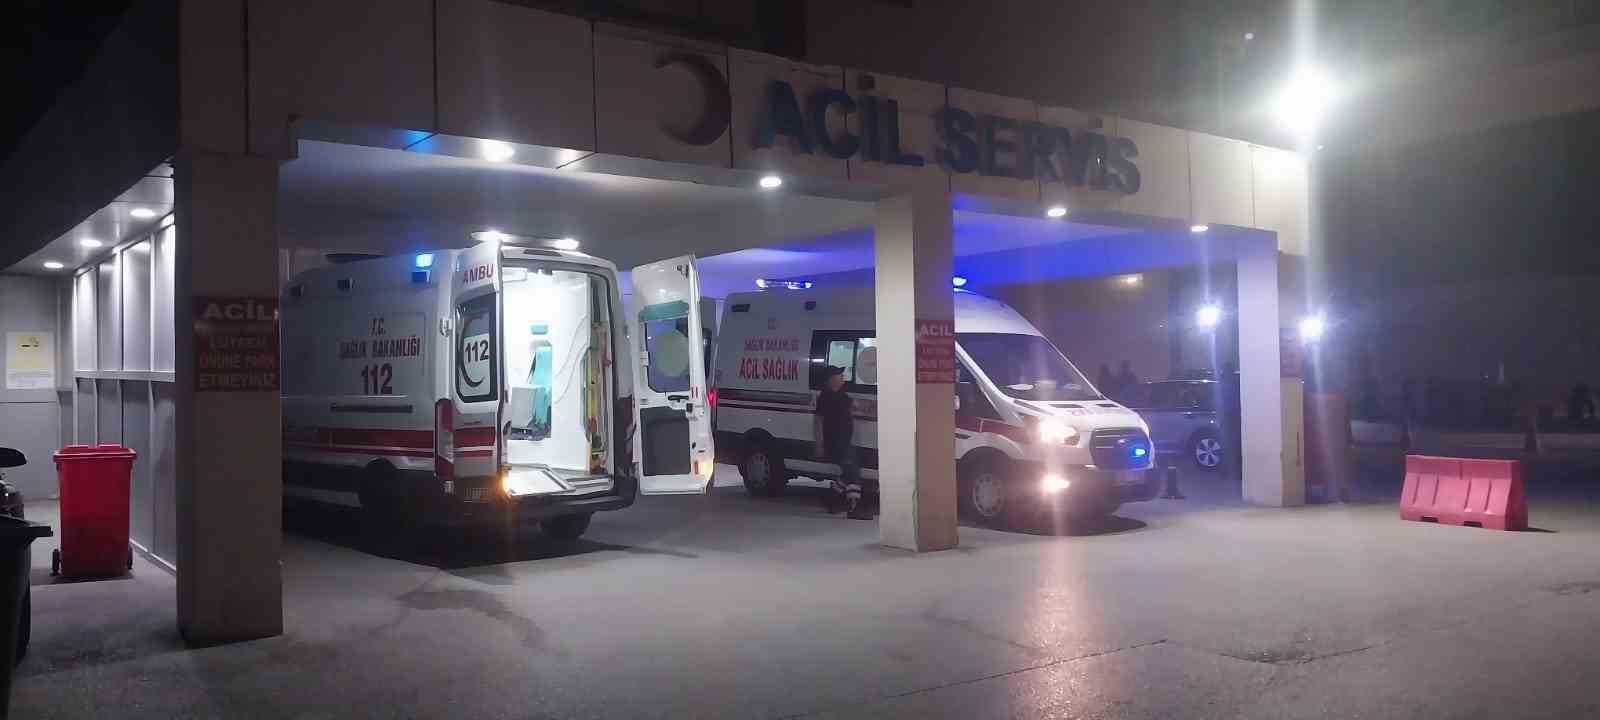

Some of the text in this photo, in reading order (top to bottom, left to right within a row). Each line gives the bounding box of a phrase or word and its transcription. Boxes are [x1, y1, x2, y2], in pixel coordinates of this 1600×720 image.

[752, 75, 1141, 195] ACİL SERVİS
[463, 264, 494, 282] AMBU
[464, 339, 489, 363] 112
[361, 363, 393, 395] 112
[762, 356, 799, 381] SAĞLIK
